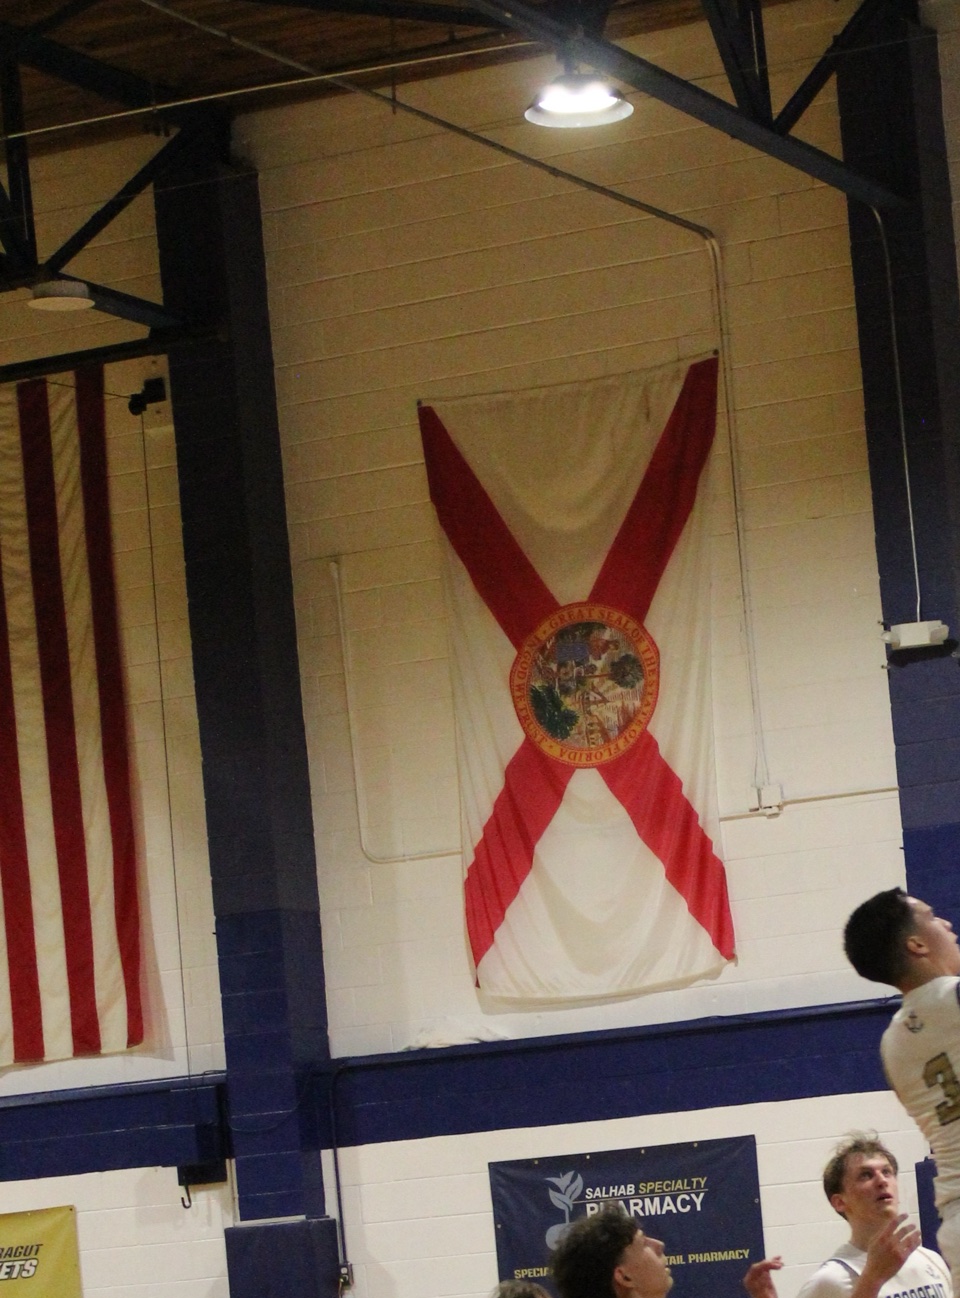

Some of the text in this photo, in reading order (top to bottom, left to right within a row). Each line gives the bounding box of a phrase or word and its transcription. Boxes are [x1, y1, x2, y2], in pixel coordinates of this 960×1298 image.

[549, 608, 595, 629] GREAT
[599, 609, 629, 631] SEAL
[559, 742, 623, 762] FLORIDA
[585, 1176, 708, 1200] SALHAB SPECIALTY
[585, 1192, 705, 1218] PRMACY
[688, 1248, 750, 1265] PHARMACY
[0, 1258, 39, 1279] ETS
